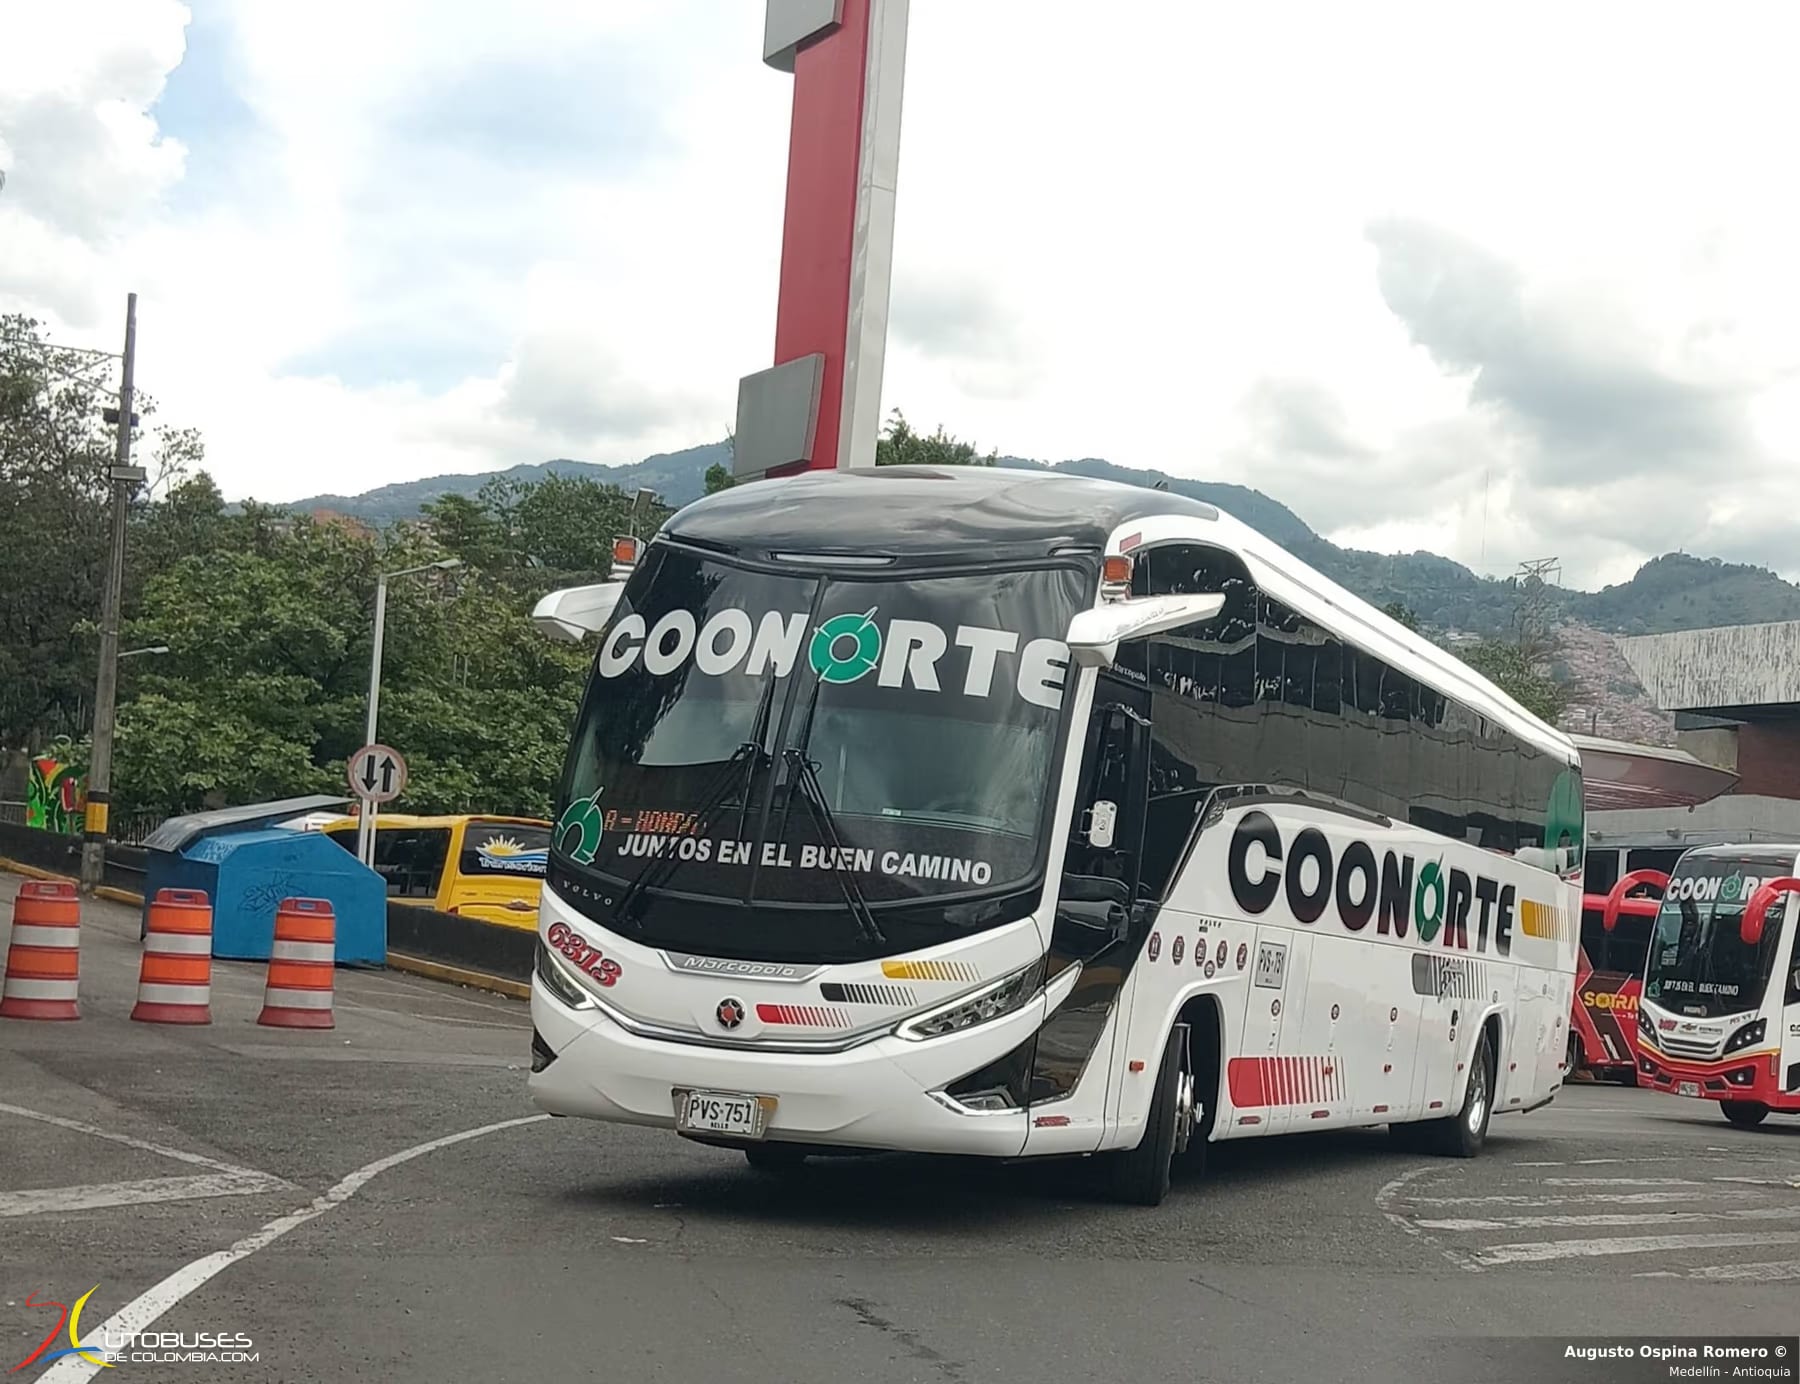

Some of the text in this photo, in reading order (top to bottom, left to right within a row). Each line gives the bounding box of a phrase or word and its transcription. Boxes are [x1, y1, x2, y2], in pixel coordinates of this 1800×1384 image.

[600, 606, 1070, 709] COONORTE
[717, 840, 753, 865] EN
[760, 843, 792, 867] EL
[800, 845, 874, 872] BUEN
[881, 851, 992, 885] CAMINO
[1228, 811, 1516, 957] COONORTE
[563, 880, 612, 905] VOLVO
[548, 921, 623, 988] 6313
[684, 956, 796, 976] Marcopolo
